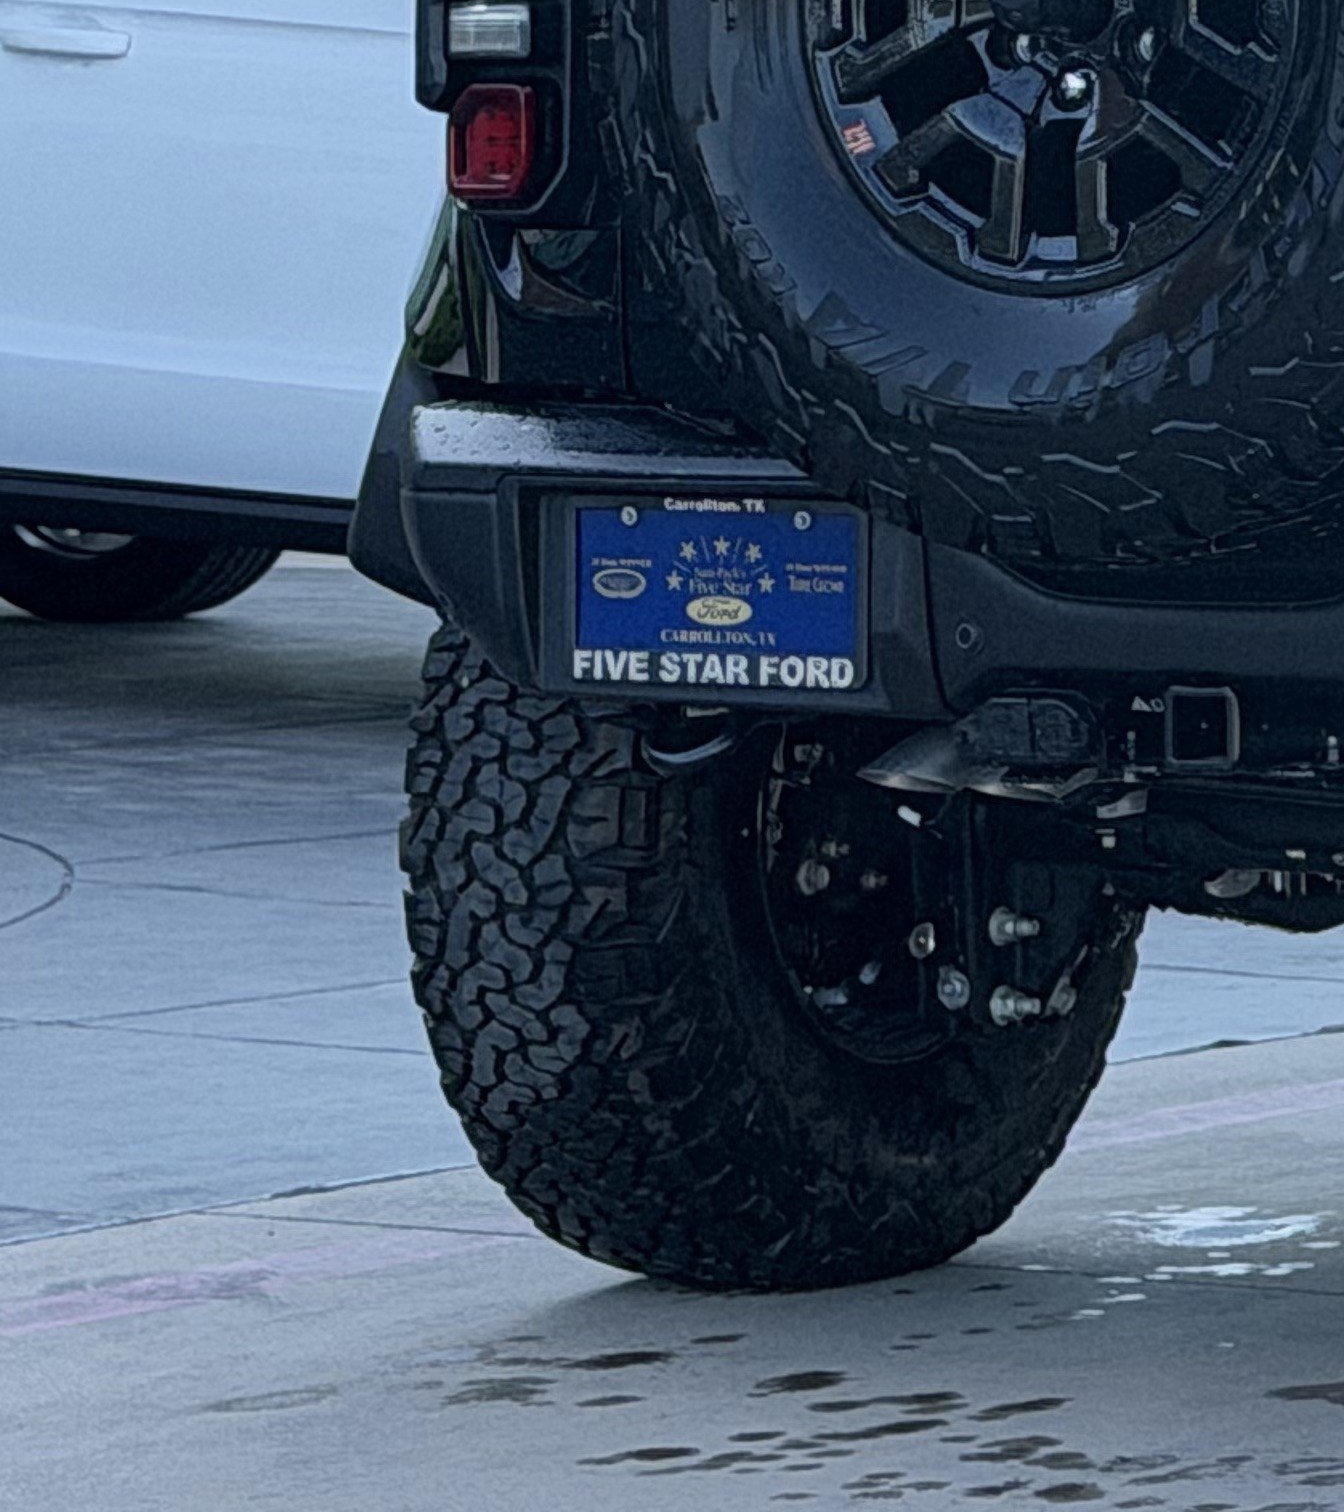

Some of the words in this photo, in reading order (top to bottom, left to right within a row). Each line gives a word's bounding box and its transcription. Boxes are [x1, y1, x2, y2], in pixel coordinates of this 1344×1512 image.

[696, 598, 743, 621] Ford
[572, 648, 650, 682] FIVE
[658, 651, 750, 685] STAR
[758, 654, 854, 689] FORD
